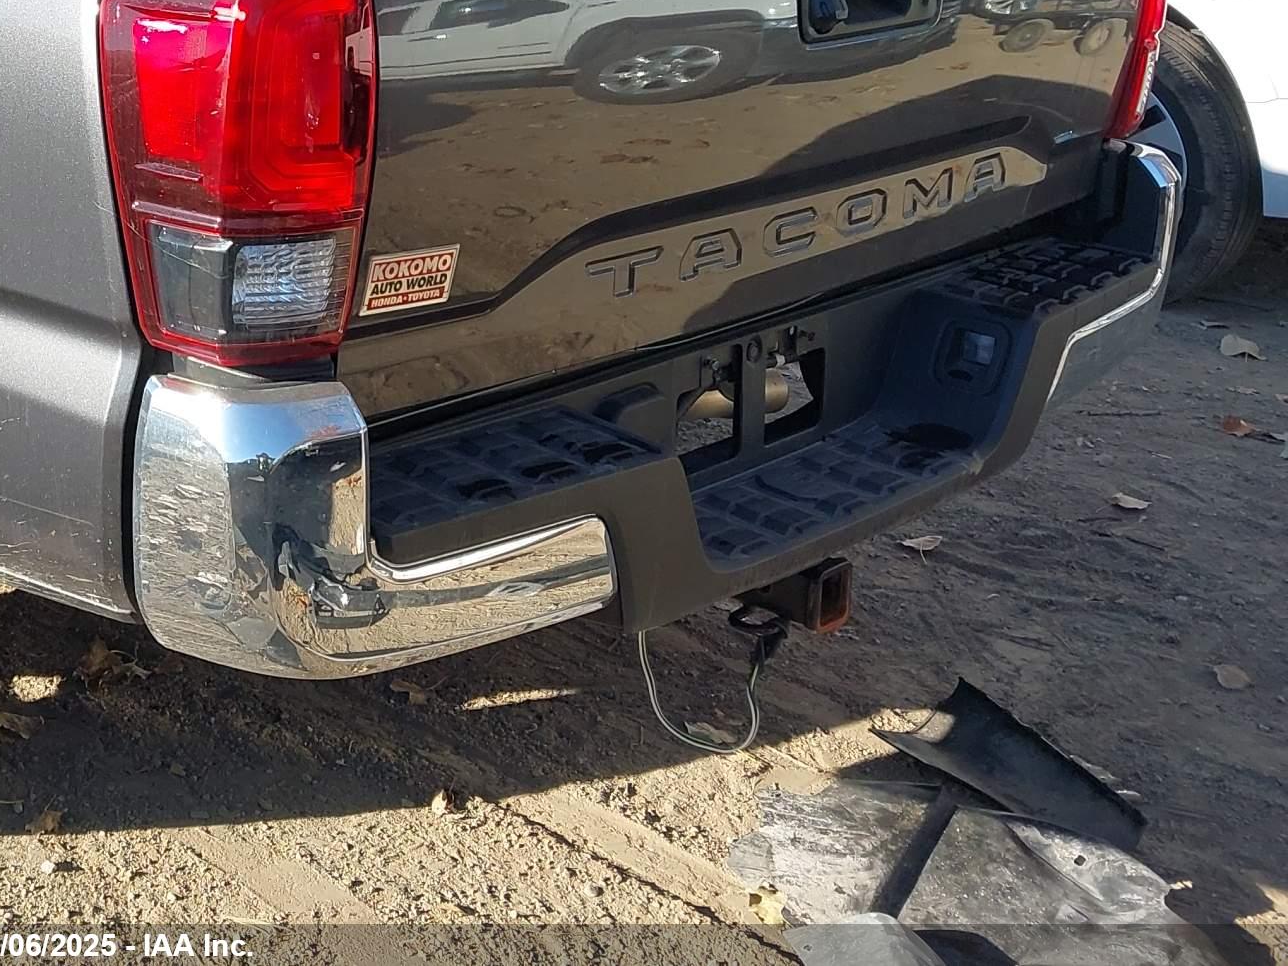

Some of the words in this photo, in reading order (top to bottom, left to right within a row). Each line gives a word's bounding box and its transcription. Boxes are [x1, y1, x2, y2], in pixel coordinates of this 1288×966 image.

[584, 151, 1008, 298] TACOMA
[372, 254, 452, 282] KOKOMO
[370, 280, 403, 296] AUTO
[406, 273, 448, 290] WORLD
